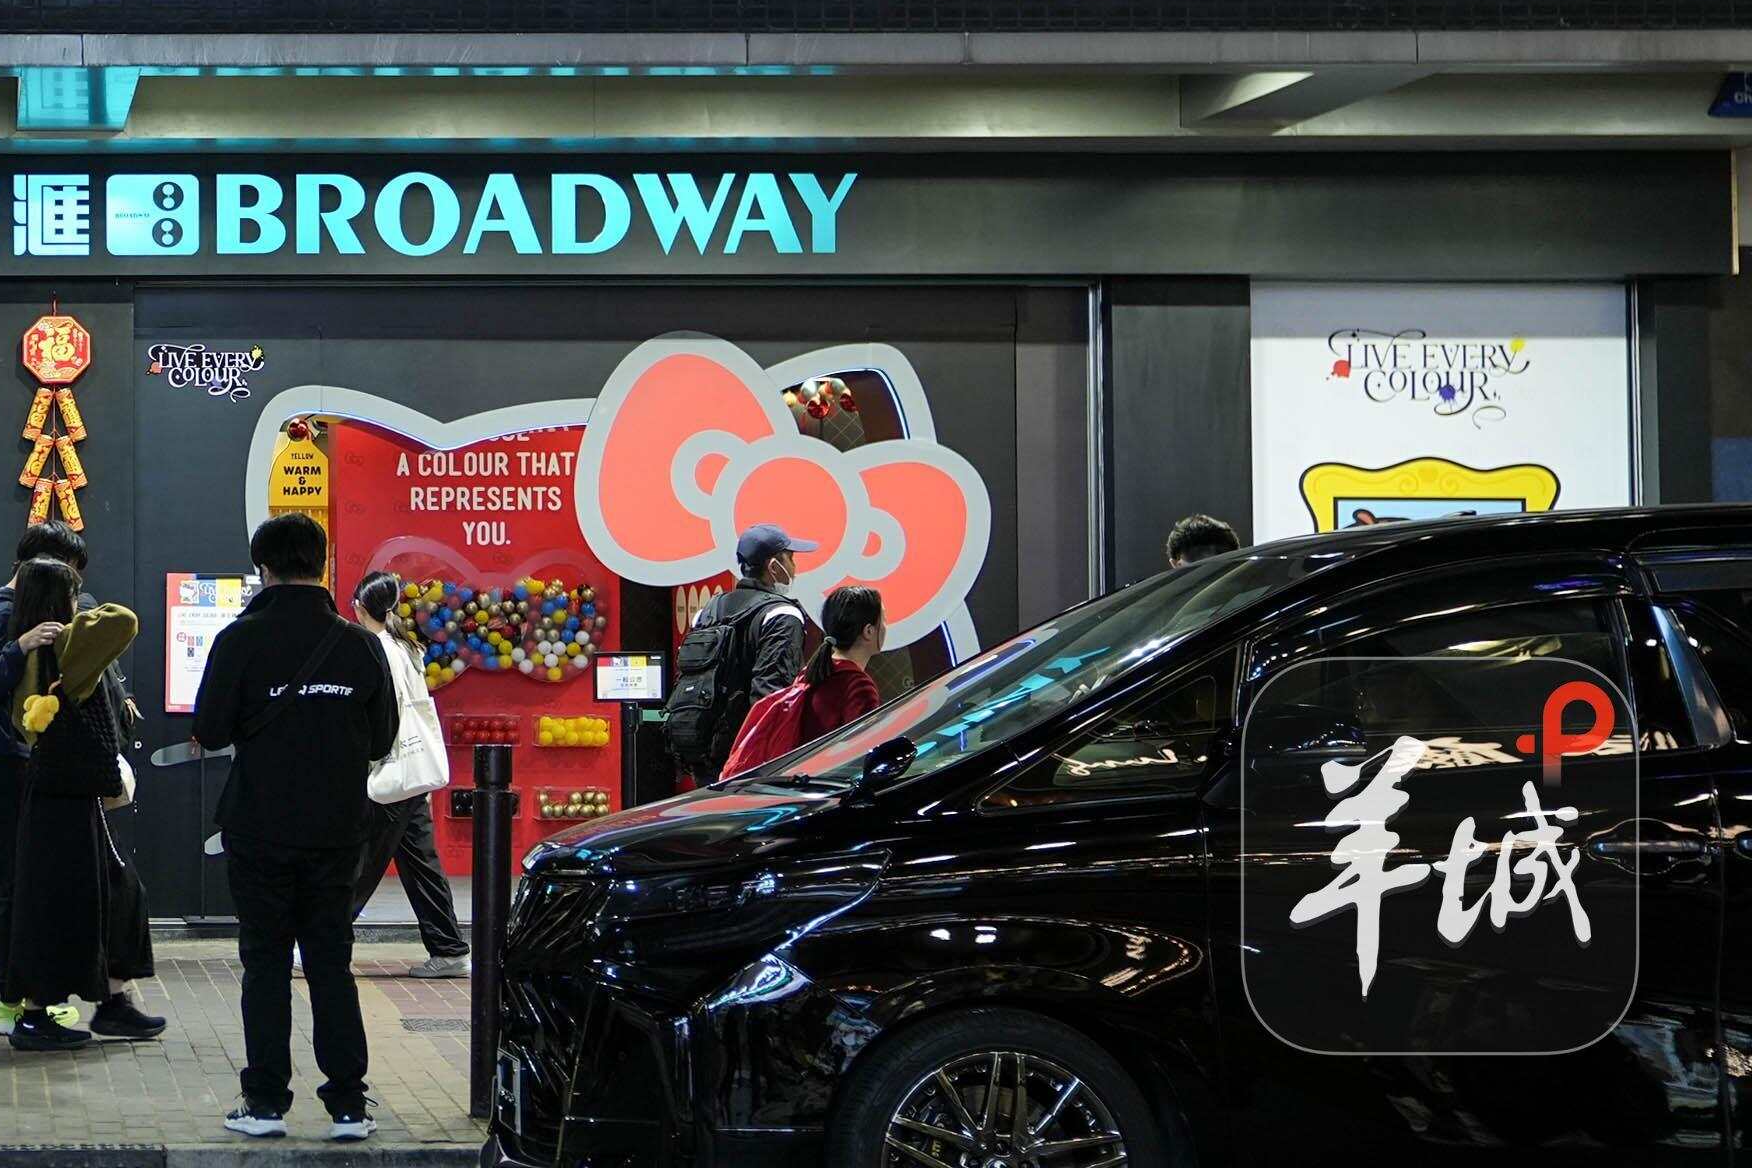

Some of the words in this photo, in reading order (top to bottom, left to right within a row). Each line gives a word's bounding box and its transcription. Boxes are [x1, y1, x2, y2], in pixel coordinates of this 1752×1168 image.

[214, 172, 858, 256] BROADWAY
[150, 346, 198, 369] LIVE
[201, 351, 259, 371] EVERY
[1333, 334, 1416, 370] LIVE
[1422, 343, 1526, 373] EVERY
[290, 453, 314, 461] YELLOW
[396, 451, 410, 477] A
[417, 451, 510, 477] COLOUR
[515, 451, 576, 477] THAT
[283, 465, 322, 476] WARM
[298, 476, 307, 486] &
[282, 486, 323, 496] HAPPY
[410, 486, 563, 512] REPRESENTS
[462, 520, 512, 546] YOU.
[307, 684, 354, 697] SPORTIF
